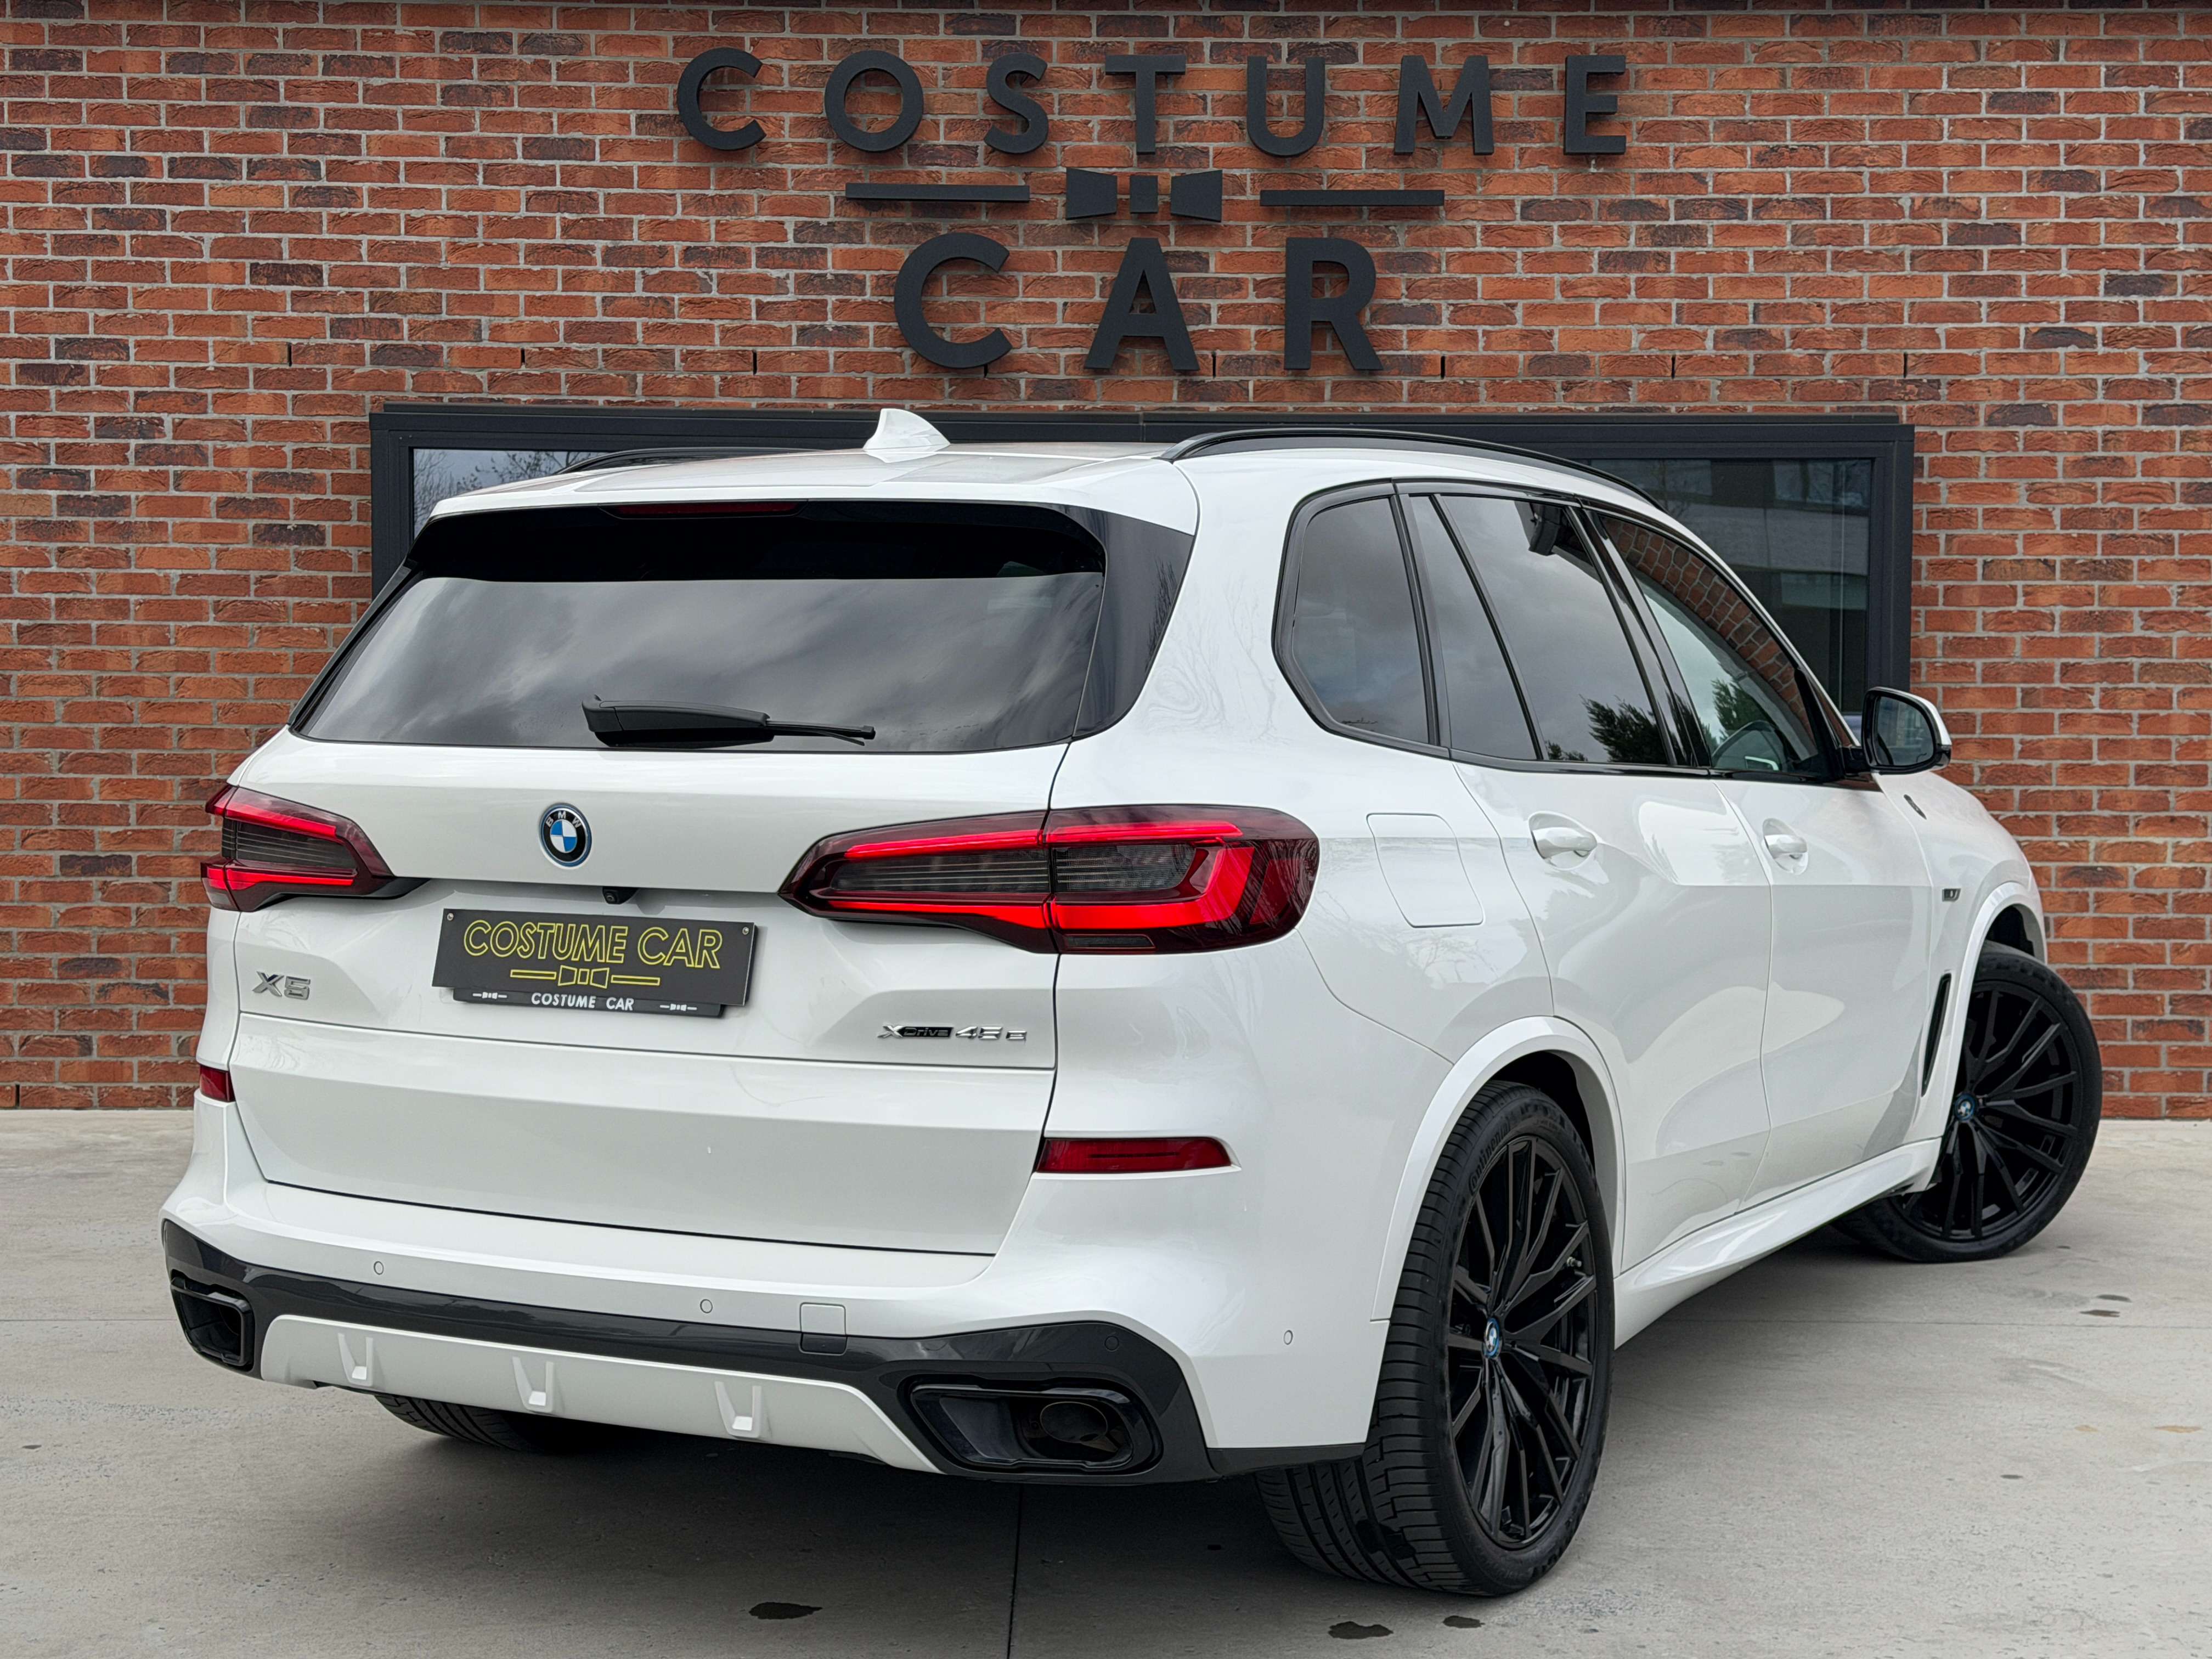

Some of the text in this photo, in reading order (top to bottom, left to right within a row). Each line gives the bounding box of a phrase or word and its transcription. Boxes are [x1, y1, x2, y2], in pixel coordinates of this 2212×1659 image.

[676, 48, 1627, 156] COSTUME
[893, 232, 1383, 371] CAR
[545, 811, 582, 828] BMW
[464, 919, 723, 969] COSTUME CAR
[251, 970, 311, 1001] X5
[531, 992, 634, 1011] COSTUME CAR
[1469, 1115, 1511, 1196] Continental
